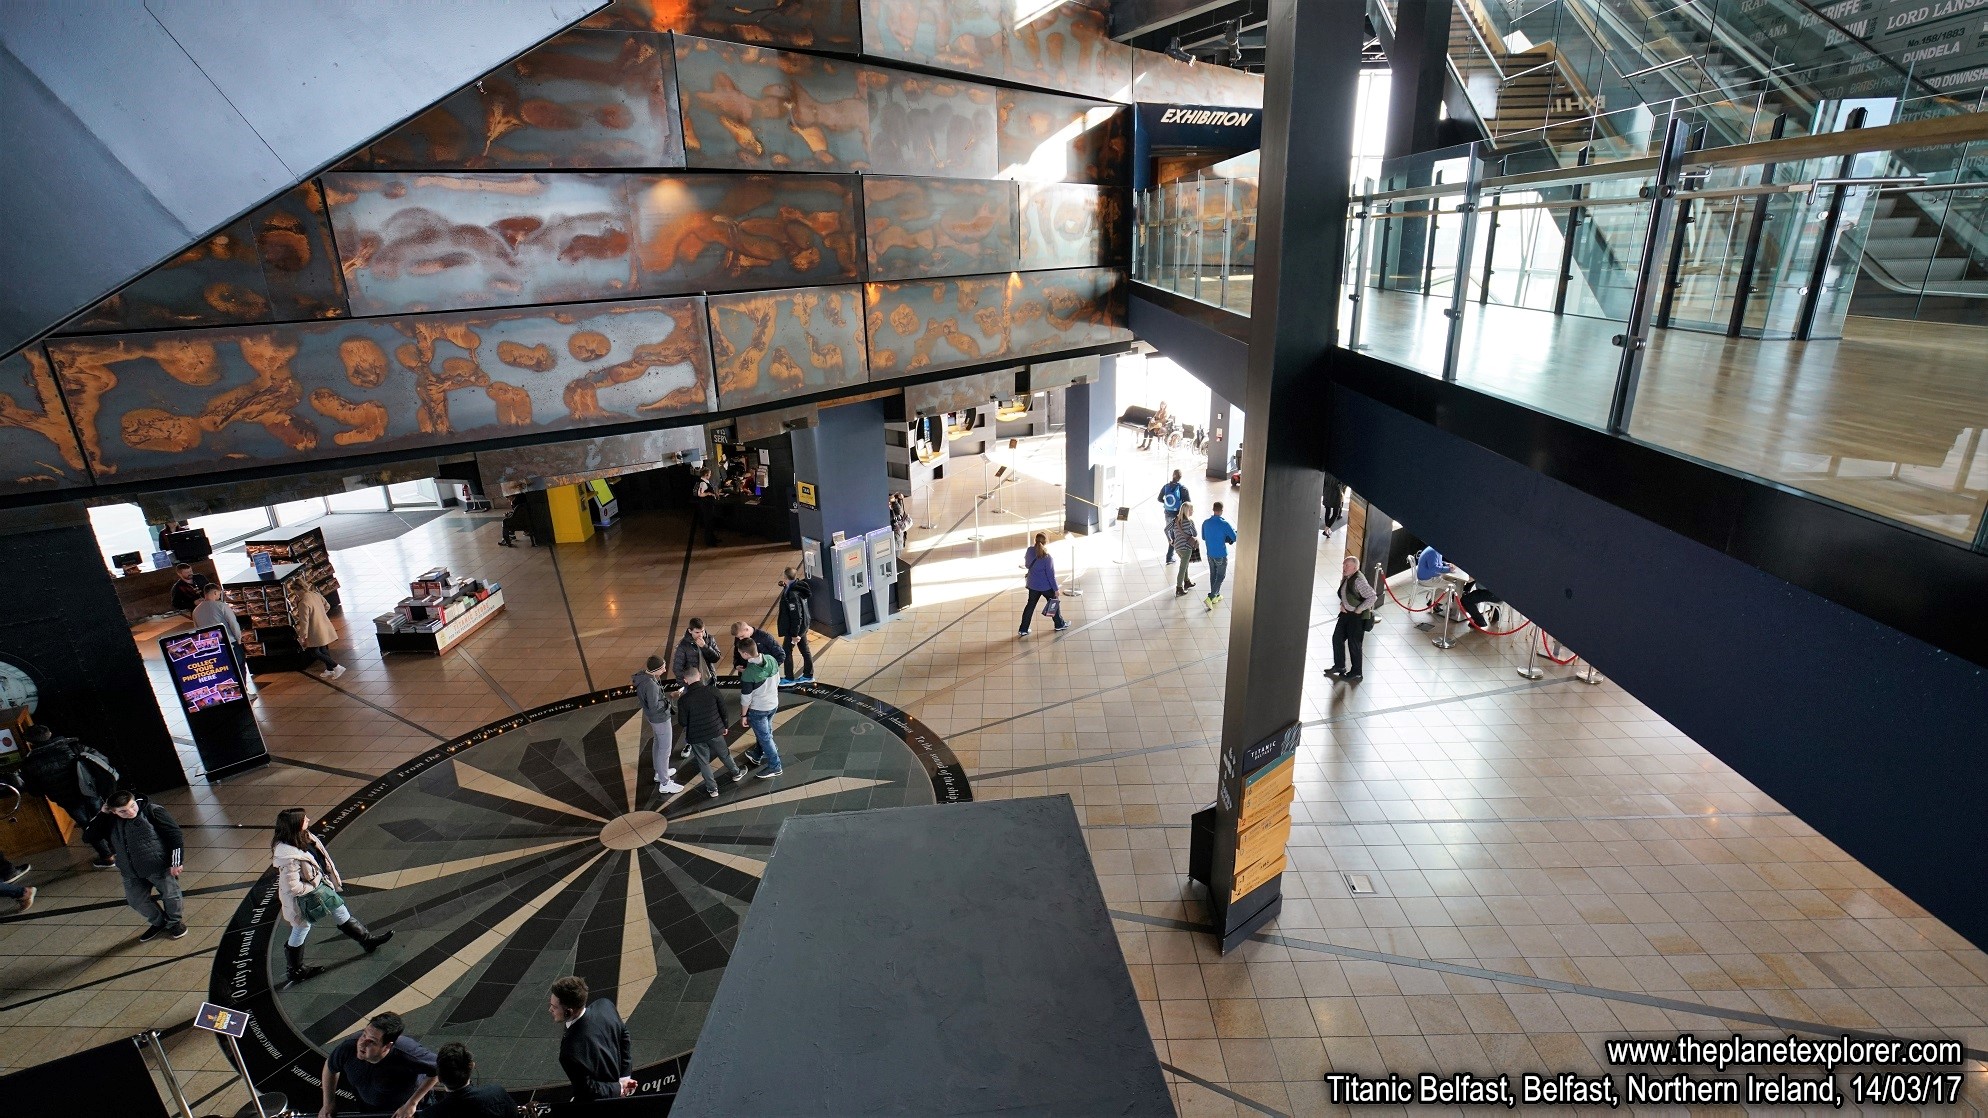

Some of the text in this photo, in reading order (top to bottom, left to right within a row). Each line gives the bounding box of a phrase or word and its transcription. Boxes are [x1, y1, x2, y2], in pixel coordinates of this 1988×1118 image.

[1886, 7, 1929, 30] LORD
[1907, 28, 1965, 47] No.158/1883
[1901, 41, 1960, 63] DUNDELA
[1160, 109, 1253, 127] EXHIBITION
[187, 657, 217, 670] COLLECT
[193, 664, 215, 673] YOUR
[182, 665, 229, 682] PHOTOGRAPH
[198, 674, 217, 683] HERE
[806, 686, 830, 695] night
[397, 760, 424, 778] From
[424, 752, 440, 765] the
[473, 732, 483, 741] of
[484, 726, 499, 737] the
[1250, 740, 1276, 758] TITANIC
[930, 753, 949, 769] sound
[332, 800, 364, 824] endless
[251, 907, 266, 924] and
[238, 929, 256, 957] sound
[232, 956, 249, 968] of
[231, 966, 252, 988] city
[231, 989, 247, 999] O
[641, 1074, 676, 1092] who
